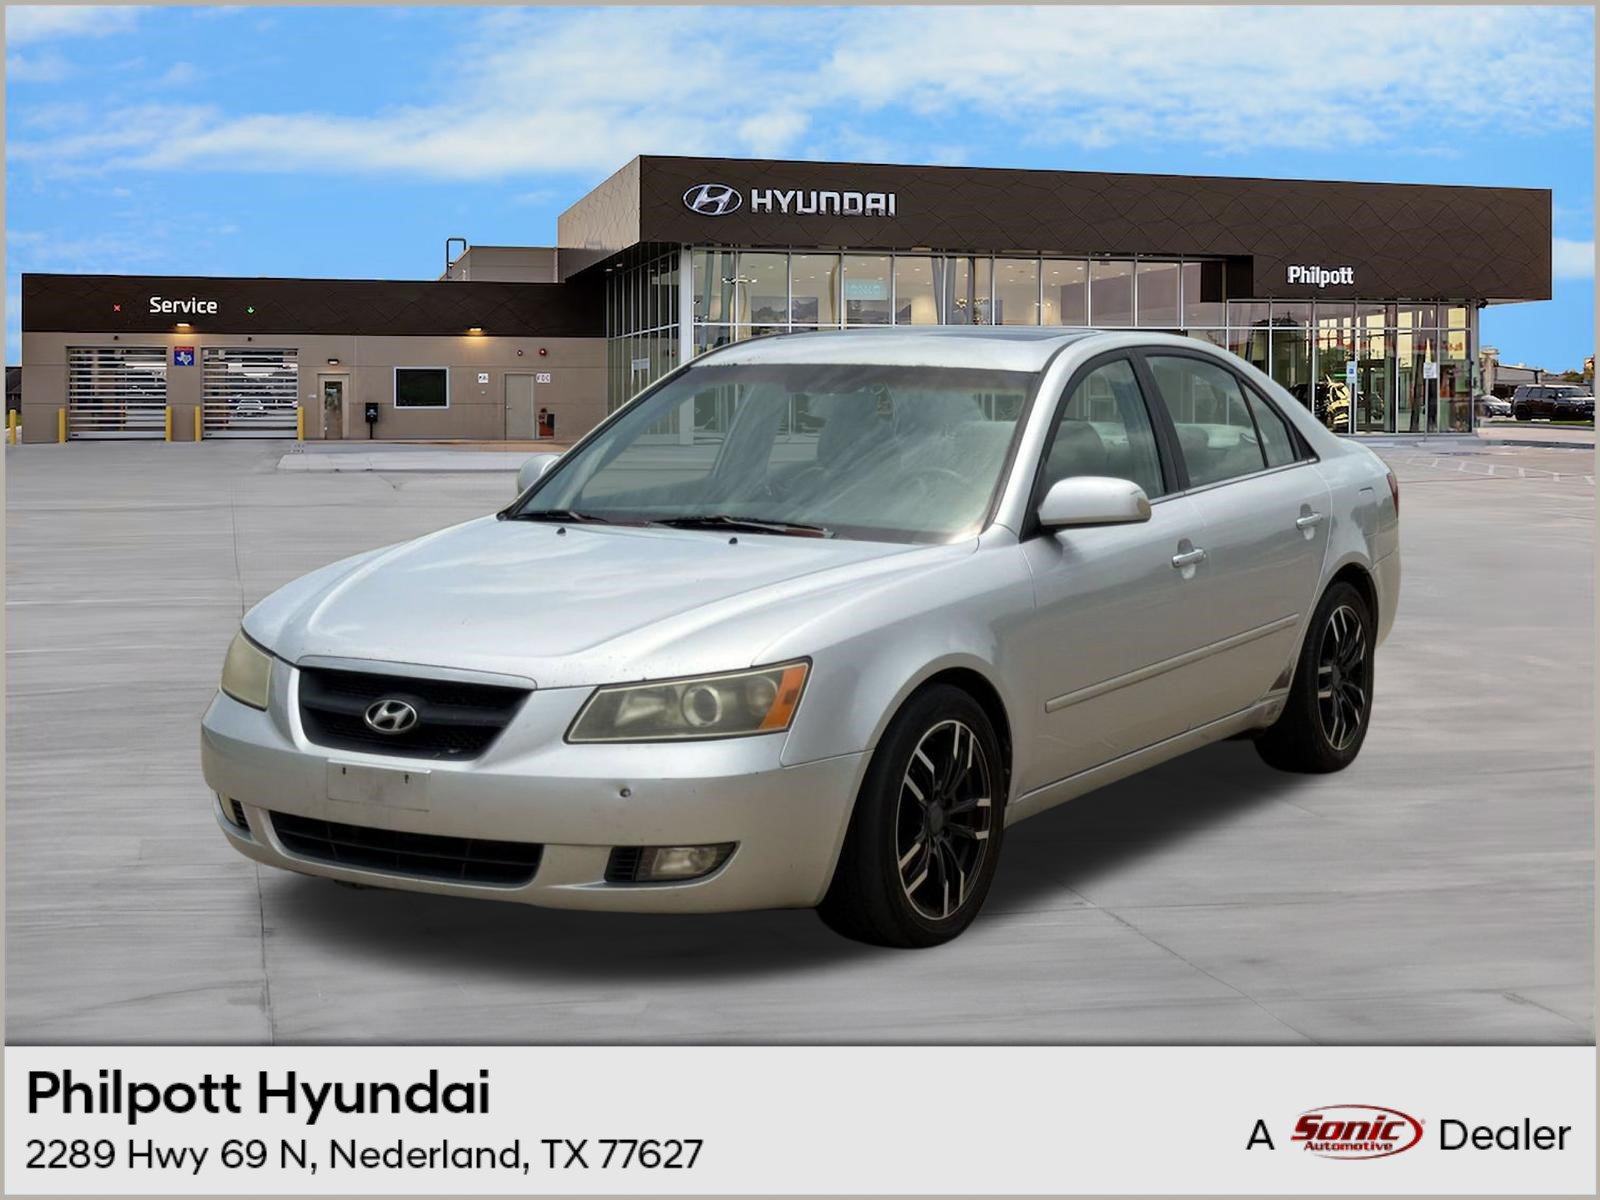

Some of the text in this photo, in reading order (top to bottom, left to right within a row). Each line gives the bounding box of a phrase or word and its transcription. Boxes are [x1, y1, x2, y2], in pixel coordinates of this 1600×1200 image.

[751, 189, 896, 216] HYUNDAI
[1287, 265, 1354, 288] Philpott
[149, 296, 218, 315] Service
